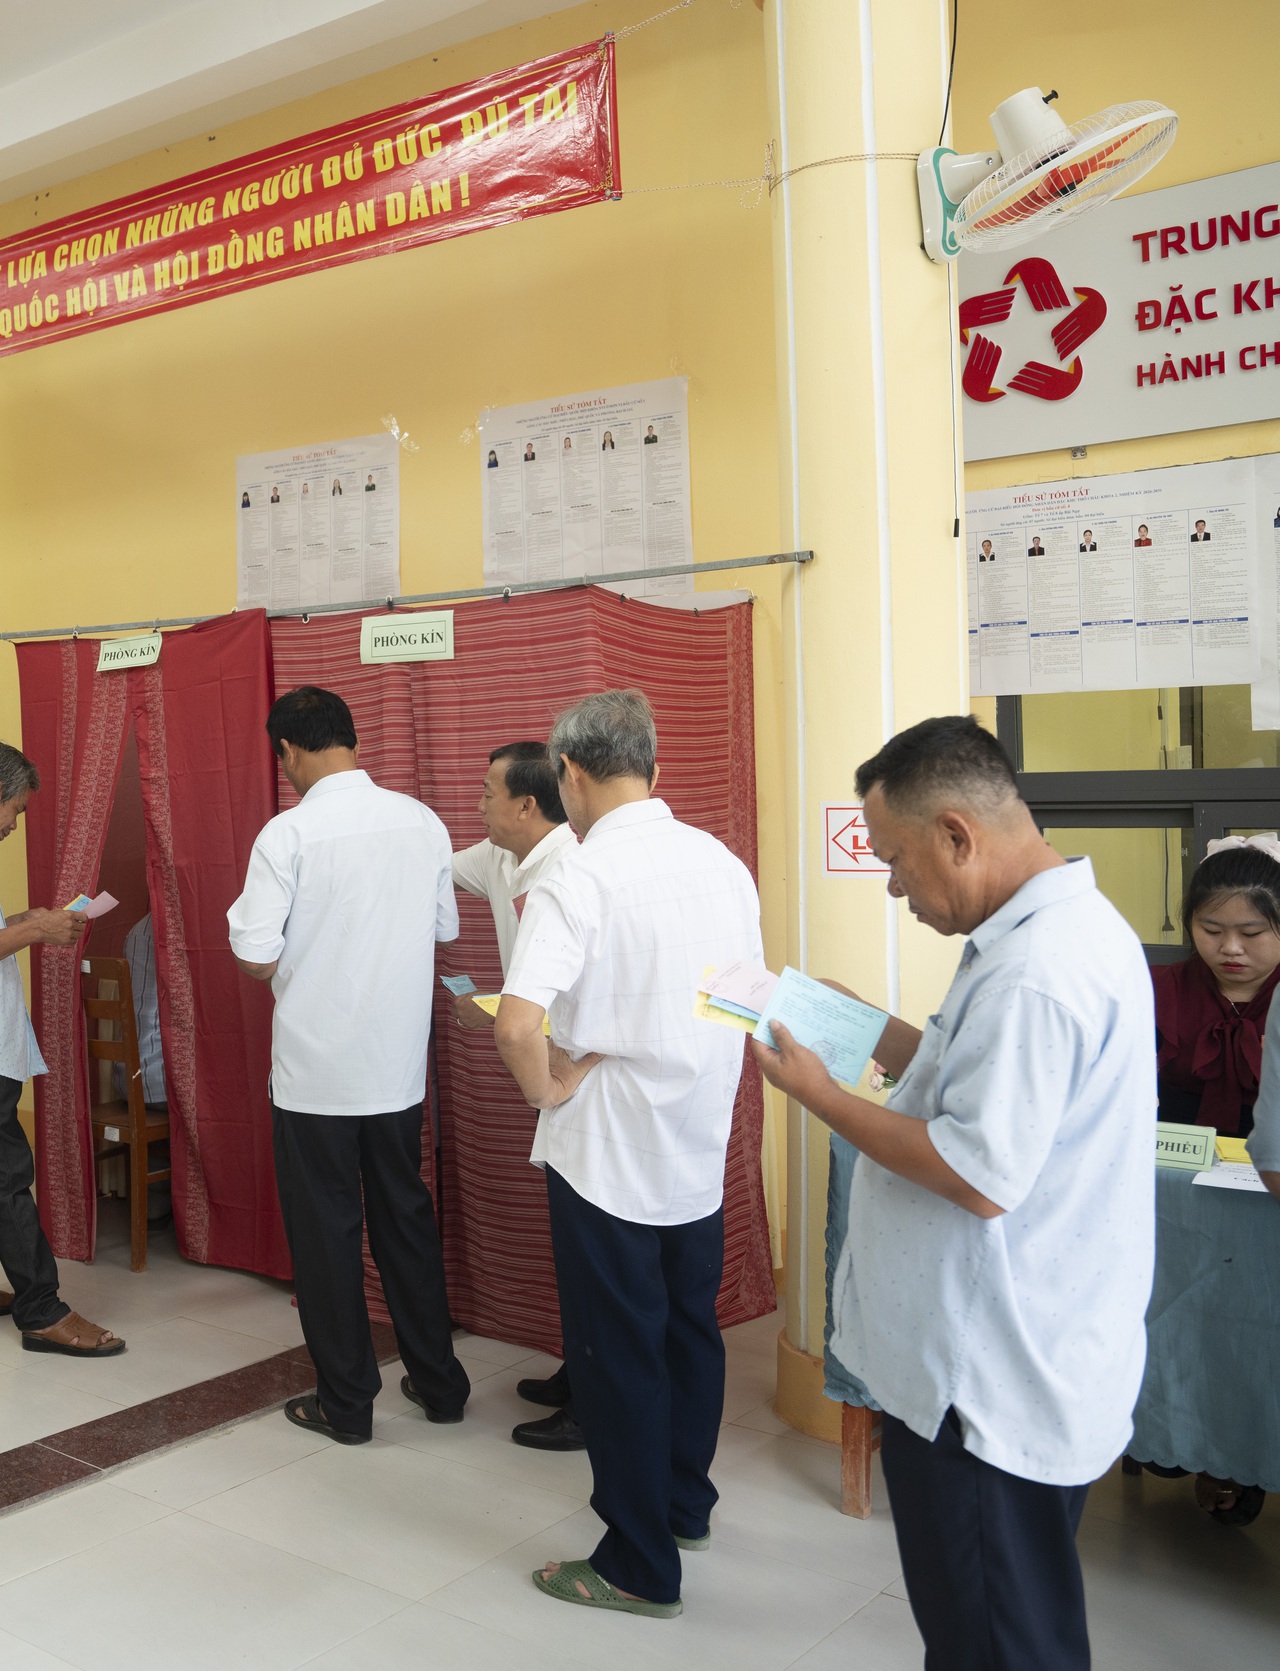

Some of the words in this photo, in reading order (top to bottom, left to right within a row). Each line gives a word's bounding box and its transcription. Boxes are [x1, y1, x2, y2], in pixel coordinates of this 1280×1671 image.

[7, 250, 48, 288] LỰA
[53, 227, 120, 269] CHỌN
[125, 197, 216, 250] NHỮNG
[222, 163, 314, 218] NGƯỜI
[320, 142, 364, 189] ĐỦ
[372, 123, 453, 174] ĐỨC,
[460, 95, 510, 147] ĐỦ
[518, 81, 579, 128] TÀI
[66, 276, 107, 317] HỘI
[112, 263, 147, 303] VÀ
[154, 250, 199, 291] HỘI
[207, 228, 284, 276] ĐỒNG
[293, 200, 377, 252] NHÂN
[385, 178, 453, 227] DÂN
[1132, 204, 1280, 263] TRUNG
[1135, 283, 1219, 334] ĐẶC
[1136, 351, 1226, 388] HÀNH
[1013, 493, 1034, 504] TIỂU
[1035, 492, 1047, 501] SỬ
[1049, 490, 1069, 500] TÓM
[1072, 486, 1090, 497] TẮT
[103, 647, 138, 662] PHÒNG
[139, 643, 157, 658] KÍN
[373, 632, 418, 649] PHÒNG
[420, 629, 445, 644] KÍN
